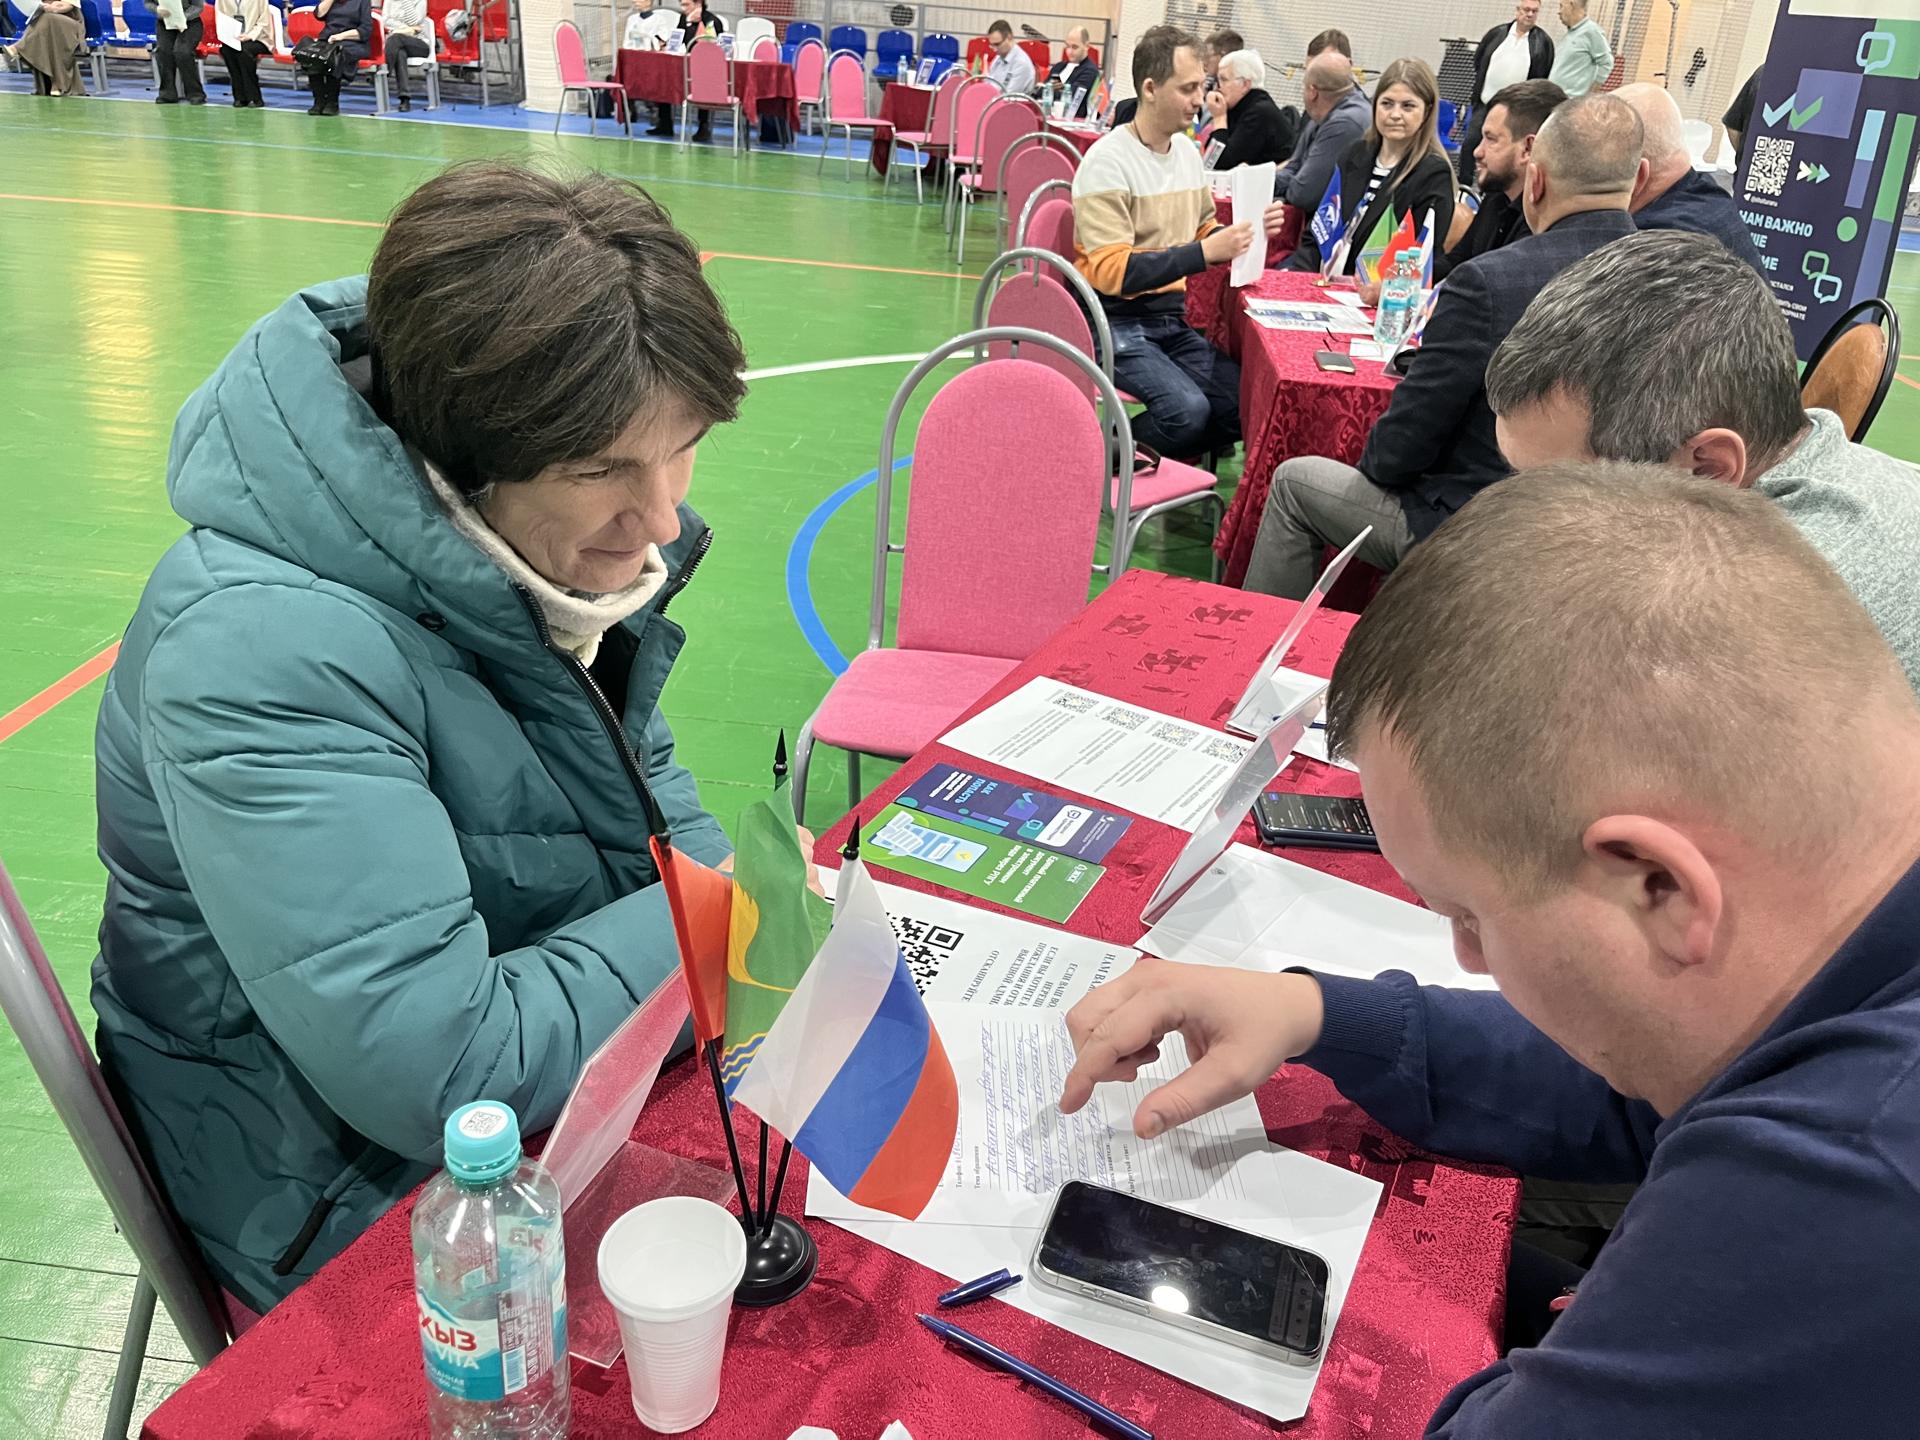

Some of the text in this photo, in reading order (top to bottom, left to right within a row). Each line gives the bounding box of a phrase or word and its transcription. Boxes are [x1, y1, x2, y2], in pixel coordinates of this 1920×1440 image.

[1764, 215, 1813, 237] ВАЖНО
[955, 778, 986, 804] ПОПАСТЬ
[981, 782, 998, 795] КАК
[1022, 851, 1045, 876] документ
[984, 870, 1000, 887] РПГУ
[1014, 855, 1059, 903] Единый платежный
[1002, 948, 1029, 985] ВЫЕЗДНОЙ
[1019, 942, 1047, 984] ПОЖЕЛАНИЯ
[1023, 946, 1059, 999] ЕСЛИ ВЫ ХОТИТЕ
[1098, 953, 1116, 972] НАМ
[962, 950, 999, 1002] ОТСКАНИРУЙТЕ
[1047, 963, 1078, 1008] ЕСЛИ ВАШ ВО
[989, 985, 1007, 1006] АДМИ
[435, 1346, 480, 1370] VITA
